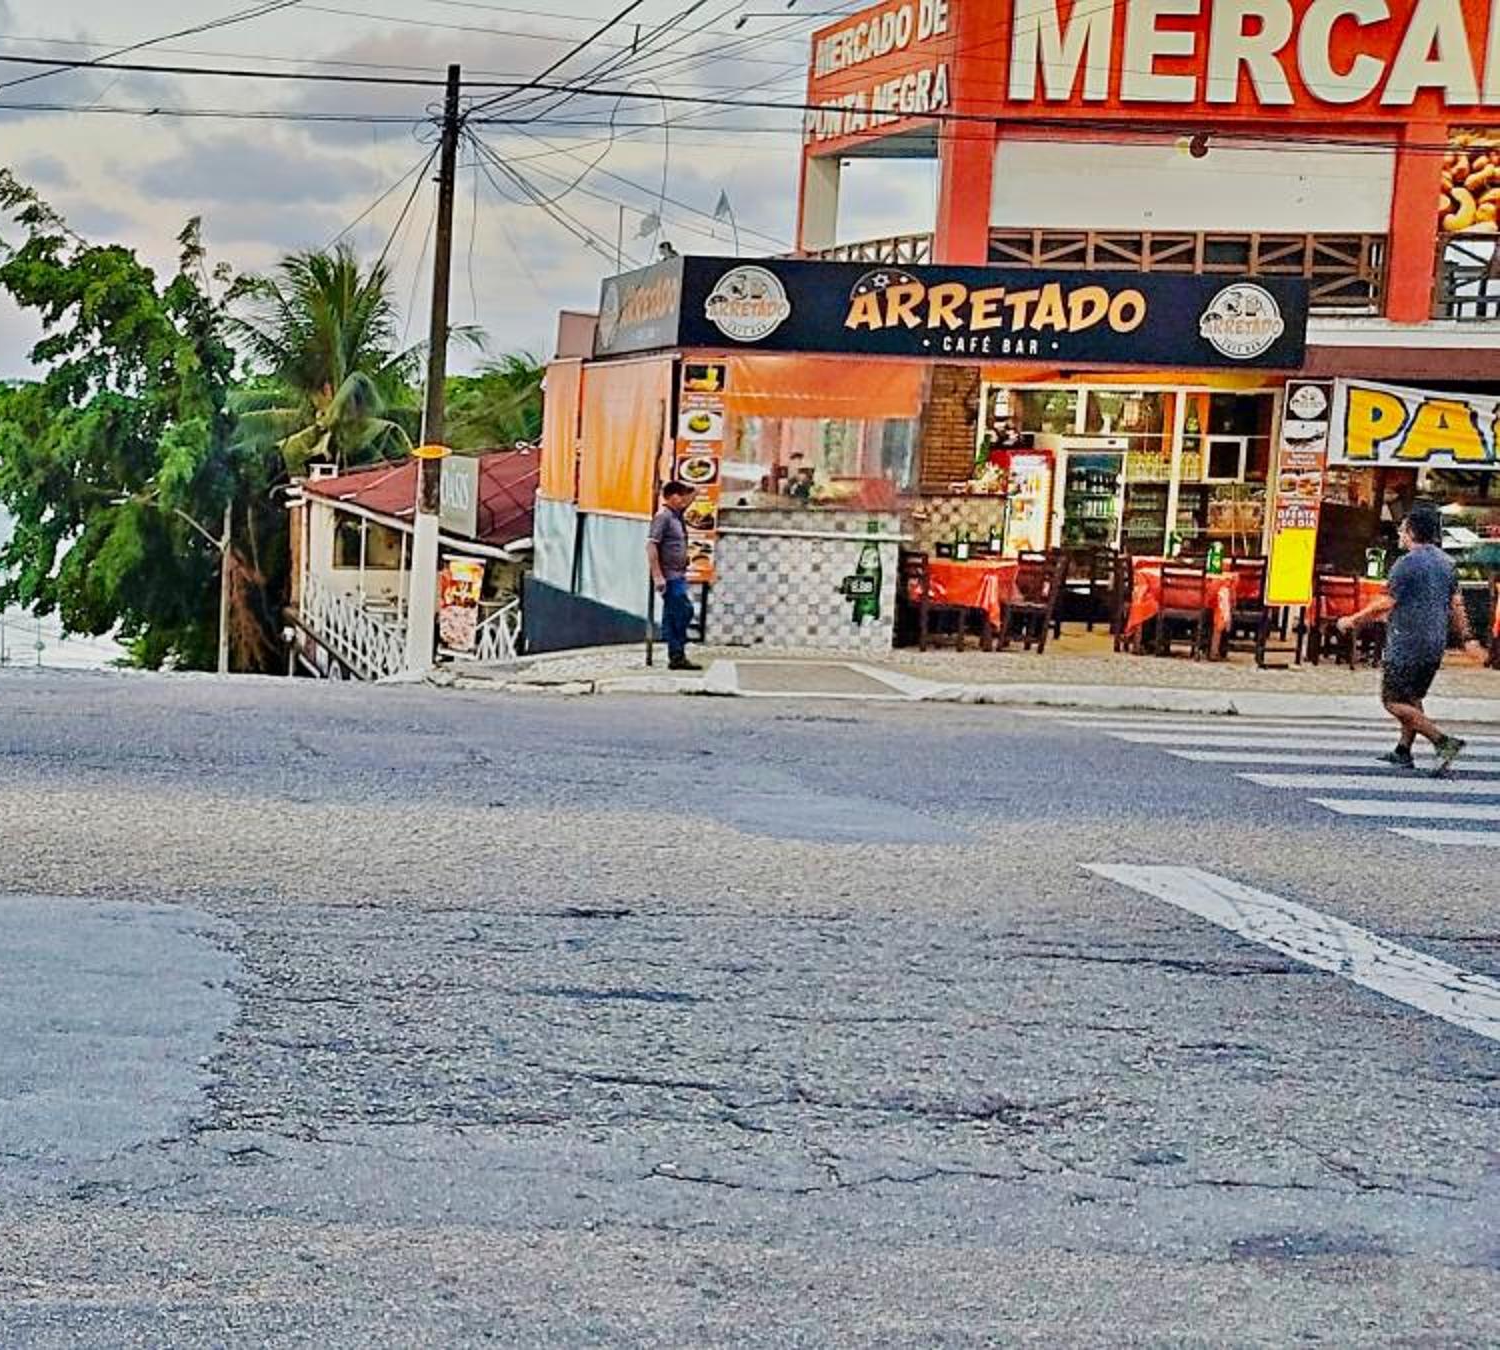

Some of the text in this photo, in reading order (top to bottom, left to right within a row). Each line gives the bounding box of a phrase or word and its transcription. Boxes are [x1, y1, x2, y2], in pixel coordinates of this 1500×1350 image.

[815, 0, 949, 78] MERCADO DE
[1008, 0, 1500, 106] MERCA
[804, 64, 949, 145] PONTA NEGRA
[844, 281, 1147, 333] ARRETADO
[943, 335, 1038, 355] CAFÉ BAR
[1344, 384, 1500, 465] PA
[1277, 510, 1316, 519] OFERTA
